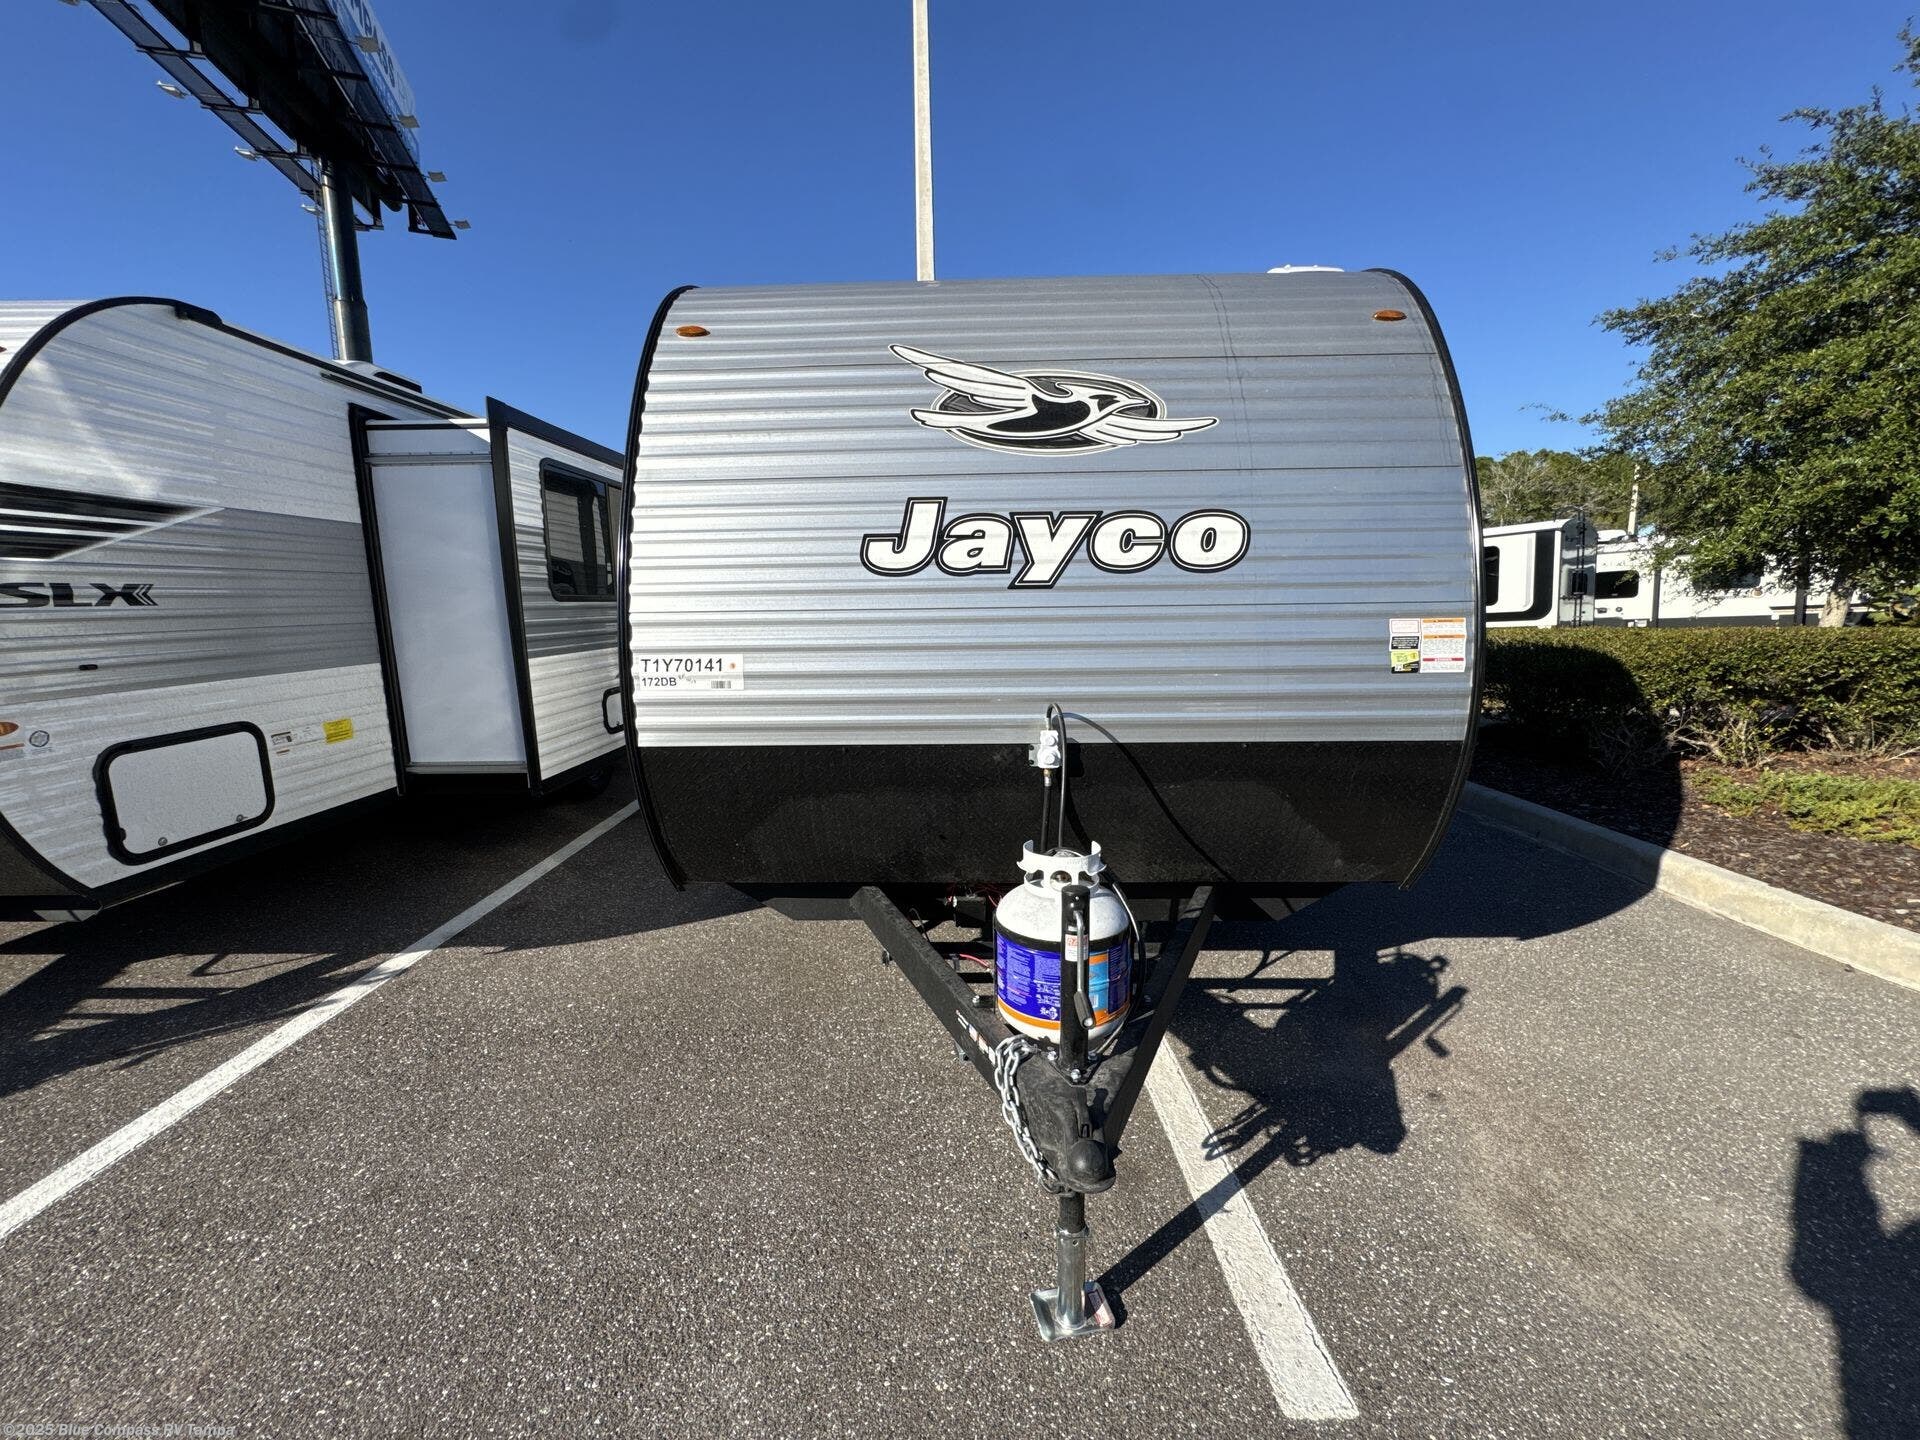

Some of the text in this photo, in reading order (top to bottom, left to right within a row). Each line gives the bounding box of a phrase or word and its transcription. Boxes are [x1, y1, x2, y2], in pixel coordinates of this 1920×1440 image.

[860, 497, 1251, 589] Jayco
[0, 583, 158, 608] SLX
[640, 658, 722, 673] T1Y70141
[642, 677, 677, 687] 172DB
